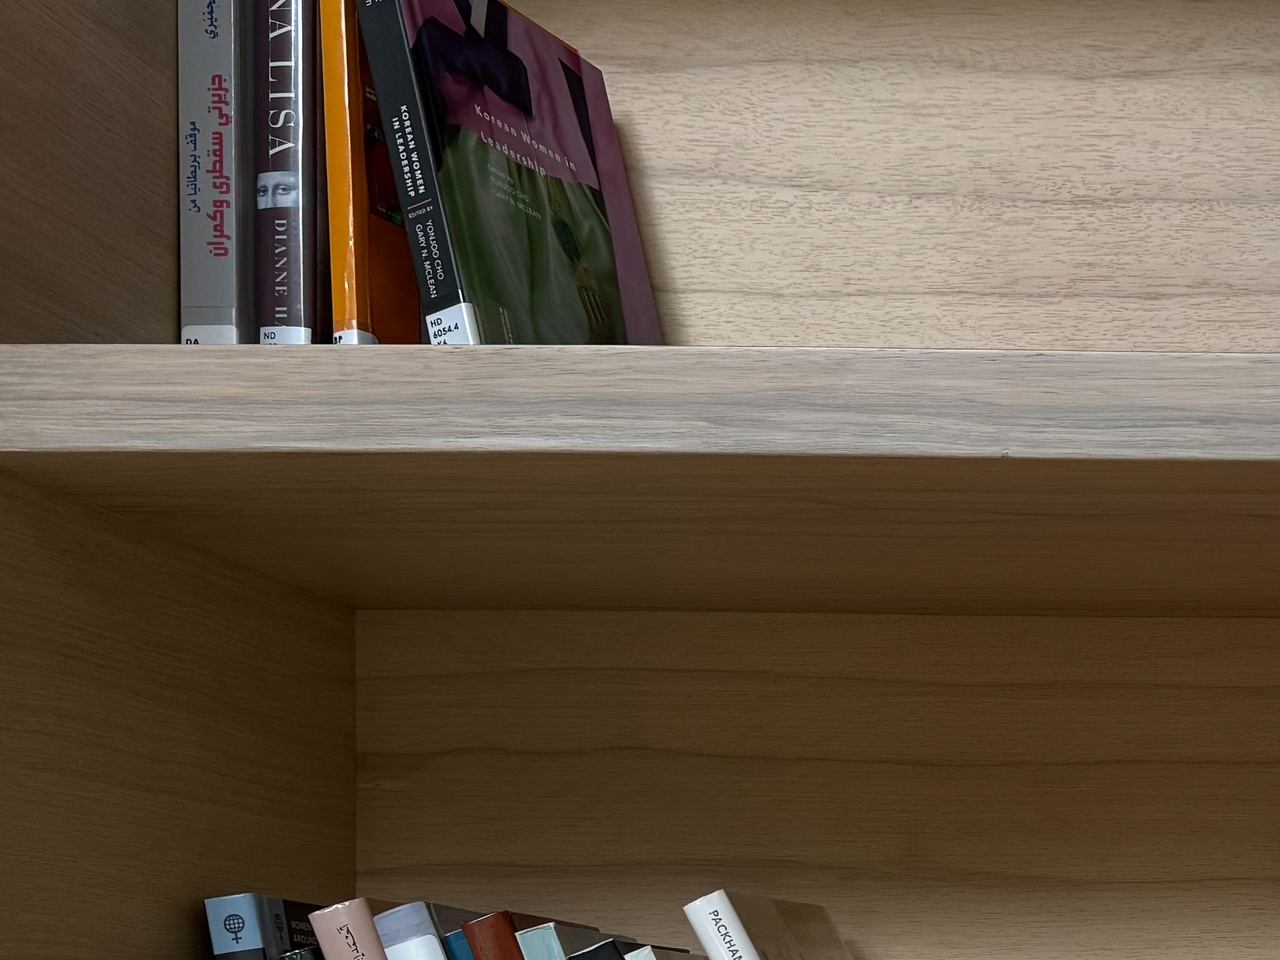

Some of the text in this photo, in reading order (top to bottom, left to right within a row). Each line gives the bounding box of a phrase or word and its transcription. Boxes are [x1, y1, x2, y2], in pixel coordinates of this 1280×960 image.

[269, 58, 295, 158] LISA
[474, 103, 576, 172] Korean Women in
[392, 117, 415, 197] IN LEADERSHIP
[400, 104, 425, 194] KOREAN WOMEN
[480, 131, 546, 177] Leadership
[185, 154, 200, 212] بريطانيا من
[275, 219, 287, 296] DIANNE
[416, 223, 437, 299] GARY MCLEAN
[426, 219, 444, 280] YONJOO CHO
[264, 332, 276, 340] ND
[430, 318, 443, 328] HD
[433, 323, 459, 339] 6054.4
